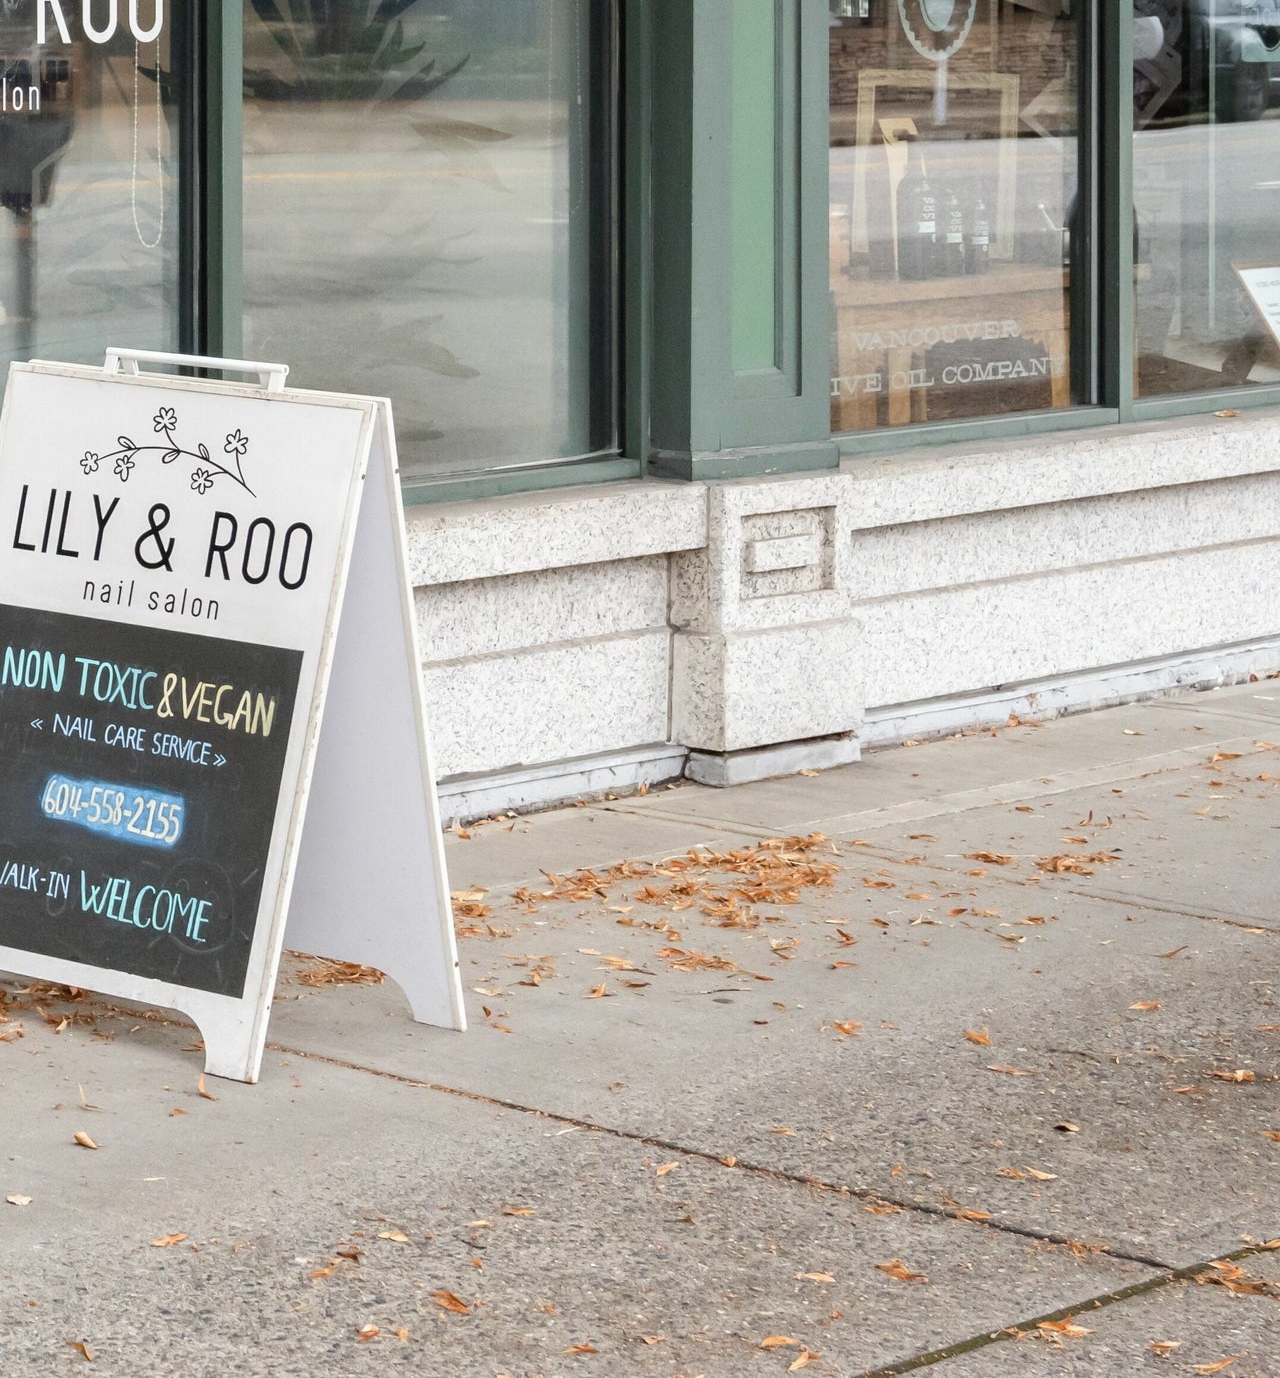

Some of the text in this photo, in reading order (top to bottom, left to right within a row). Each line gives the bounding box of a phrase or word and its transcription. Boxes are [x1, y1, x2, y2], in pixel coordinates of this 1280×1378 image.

[851, 319, 1021, 352] VANCOUVER
[891, 368, 935, 391] OIL
[942, 356, 1068, 385] COMPANY
[12, 484, 313, 590] LILY & ROO
[83, 580, 220, 620] nail salon
[1, 646, 66, 692] NON
[75, 657, 158, 710] TOXIC
[52, 713, 97, 742] NAIL
[104, 723, 147, 751] CARE
[44, 779, 182, 844] 604-558-2155
[80, 869, 213, 943] WELCOME
